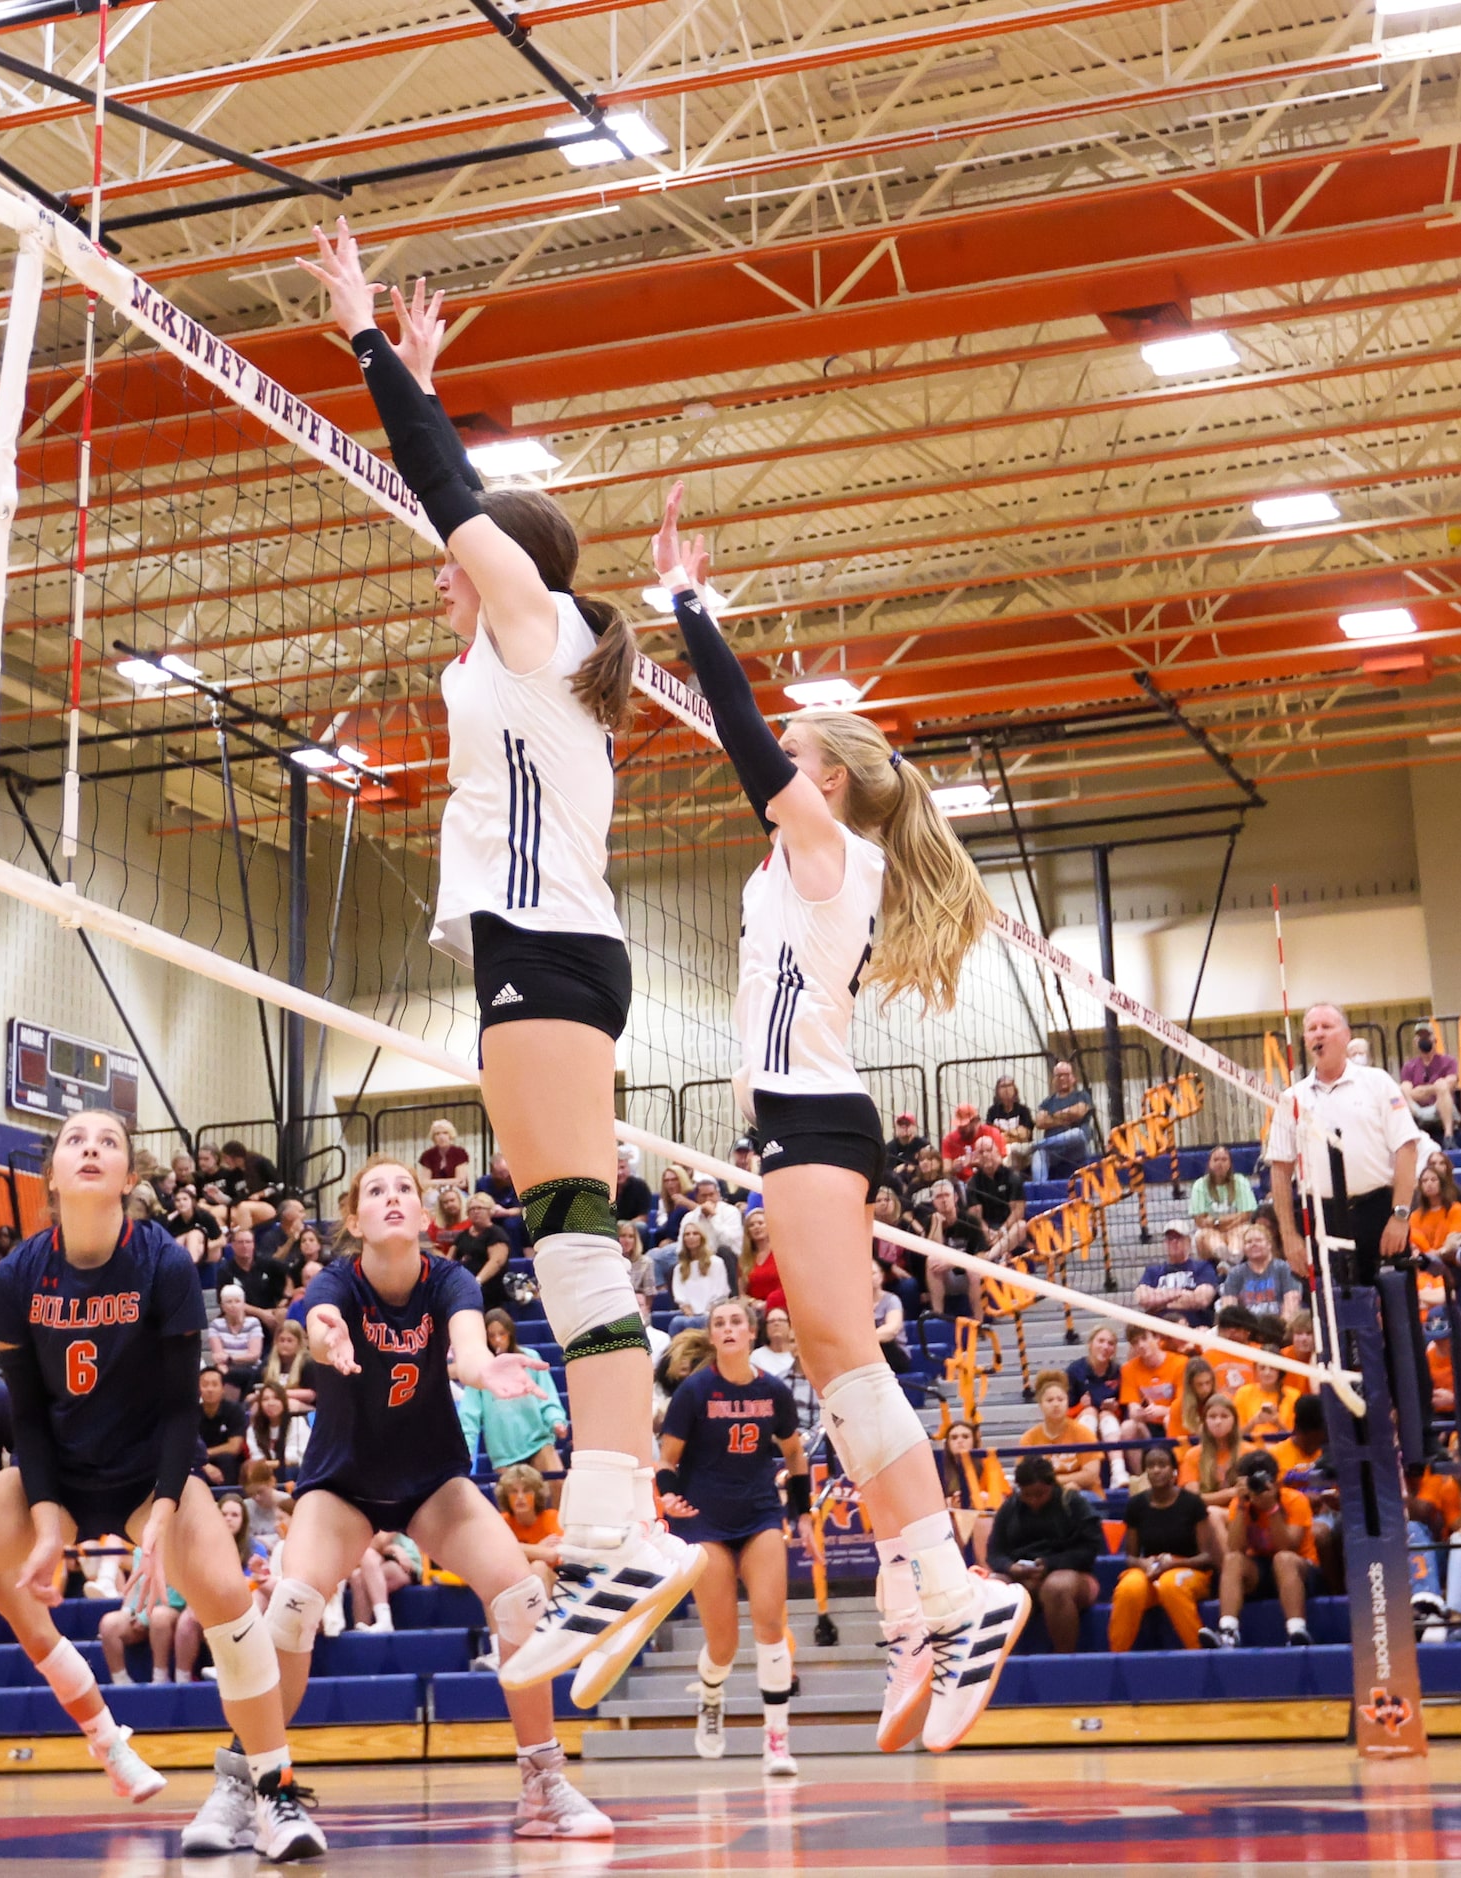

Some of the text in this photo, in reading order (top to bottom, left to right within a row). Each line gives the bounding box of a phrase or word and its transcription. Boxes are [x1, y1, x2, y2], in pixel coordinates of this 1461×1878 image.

[255, 373, 322, 446] NORTH
[330, 426, 419, 517] BULLDOGS
[651, 663, 712, 727] BULLDOGS
[491, 995, 523, 1006] adidas
[20, 1026, 44, 1048] HOME
[29, 1291, 140, 1329] BULLDOGS
[66, 1340, 98, 1395] 6
[388, 1363, 419, 1407] 2
[727, 1422, 759, 1454] 12
[1368, 1562, 1391, 1680] sports imports
